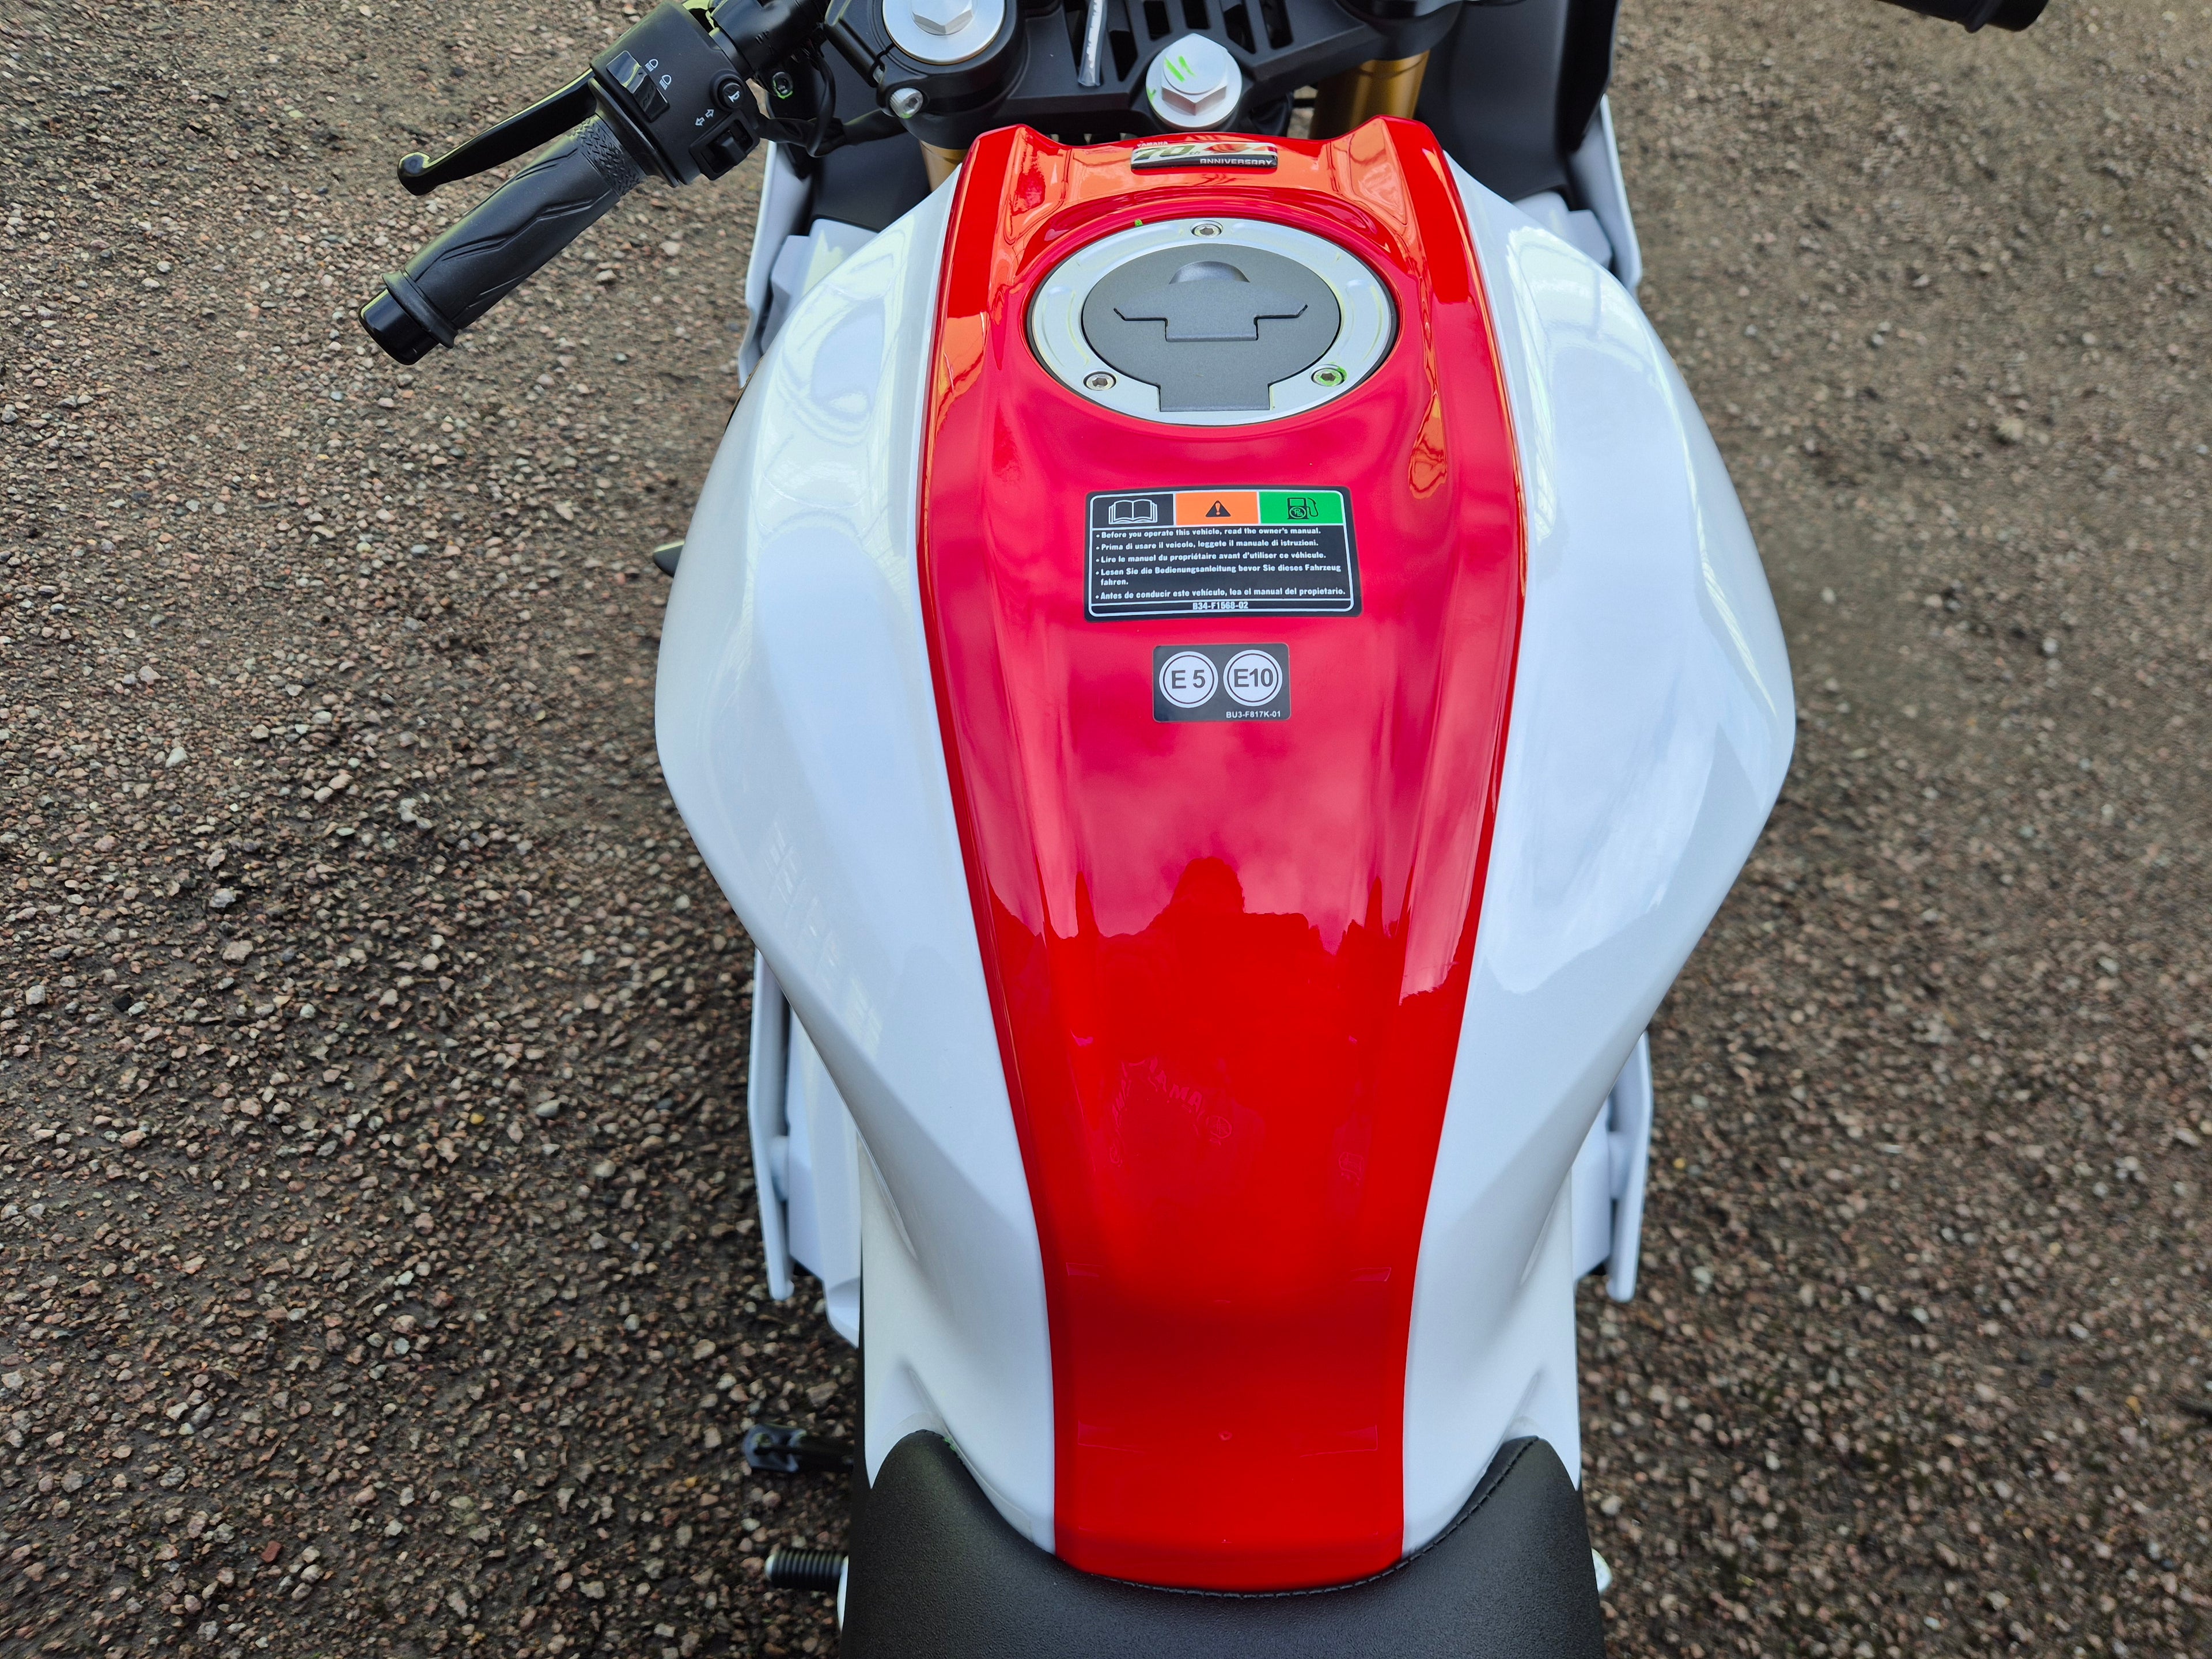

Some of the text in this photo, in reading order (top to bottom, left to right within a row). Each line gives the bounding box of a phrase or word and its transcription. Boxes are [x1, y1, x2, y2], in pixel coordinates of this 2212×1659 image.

[1170, 553, 1217, 562] propriétaire
[1155, 565, 1236, 574] Bedienungsanleitung
[1305, 564, 1341, 572] Fahrzeug
[1137, 590, 1171, 598] conducir
[1192, 588, 1227, 597] vehículo,
[1300, 587, 1346, 596] propietario.
[1234, 668, 1274, 687] E10
[1226, 710, 1281, 718] BU3-F817K-01
